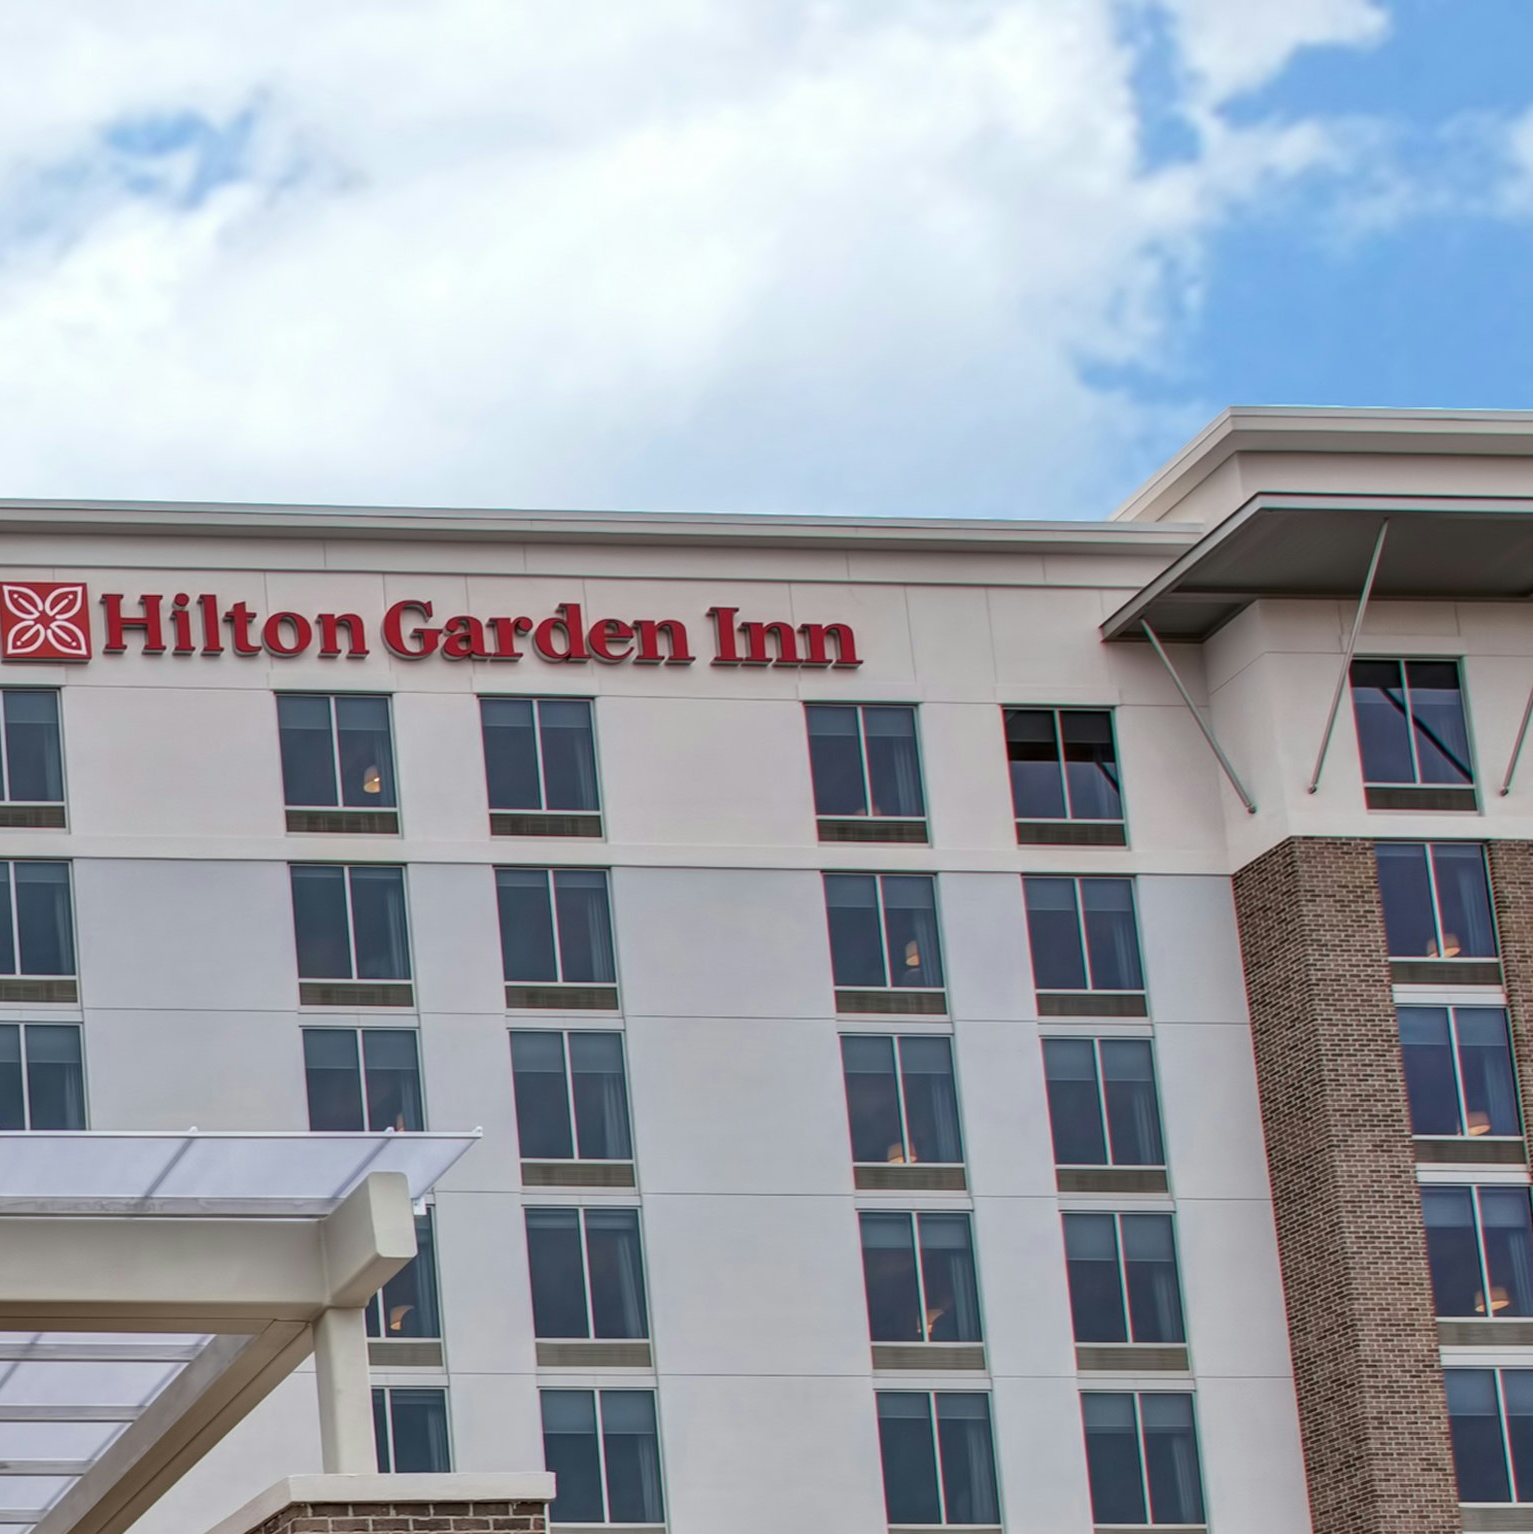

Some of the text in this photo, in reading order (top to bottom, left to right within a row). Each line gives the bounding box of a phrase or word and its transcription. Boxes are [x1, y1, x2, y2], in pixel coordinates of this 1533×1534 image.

[100, 592, 865, 669] Hilton Garden Inn
